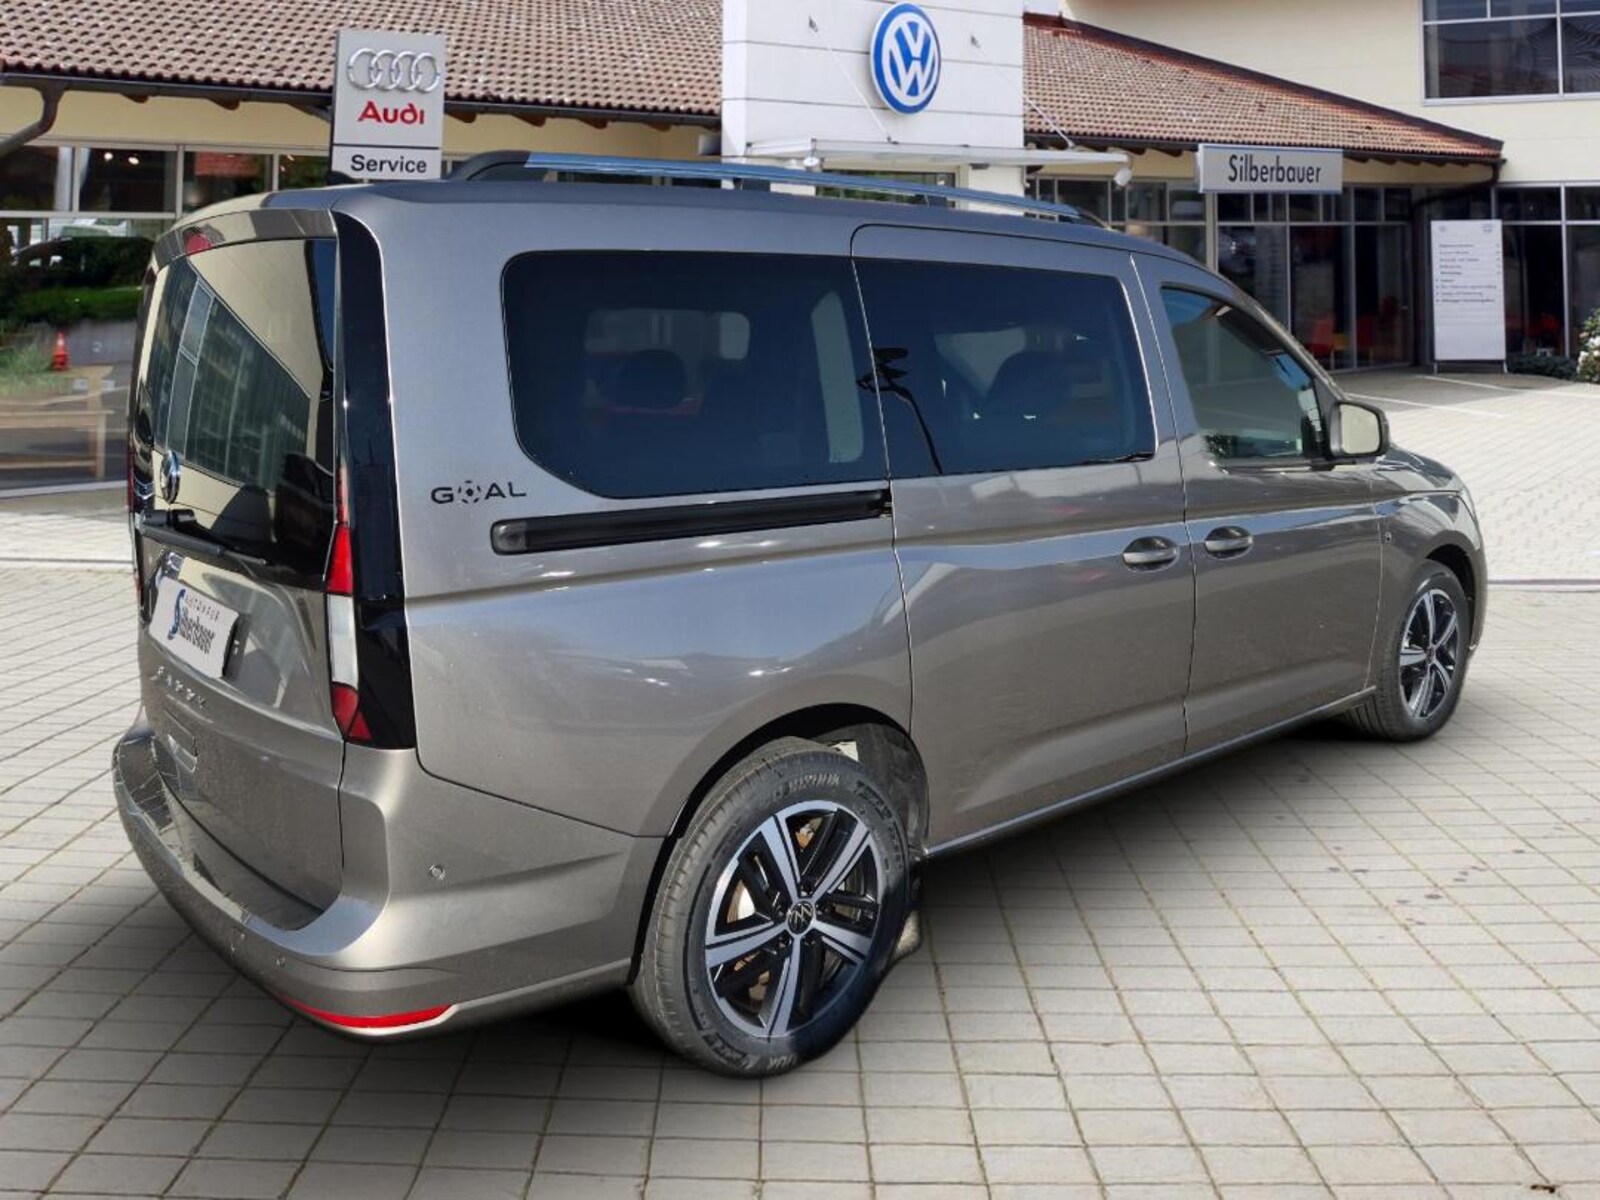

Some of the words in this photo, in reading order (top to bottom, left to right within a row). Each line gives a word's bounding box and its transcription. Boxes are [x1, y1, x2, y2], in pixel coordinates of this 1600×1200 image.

[879, 10, 938, 108] VW
[358, 101, 424, 125] Audi
[350, 154, 427, 173] Service
[1228, 154, 1321, 183] Silberbauer
[431, 480, 527, 504] GOAL
